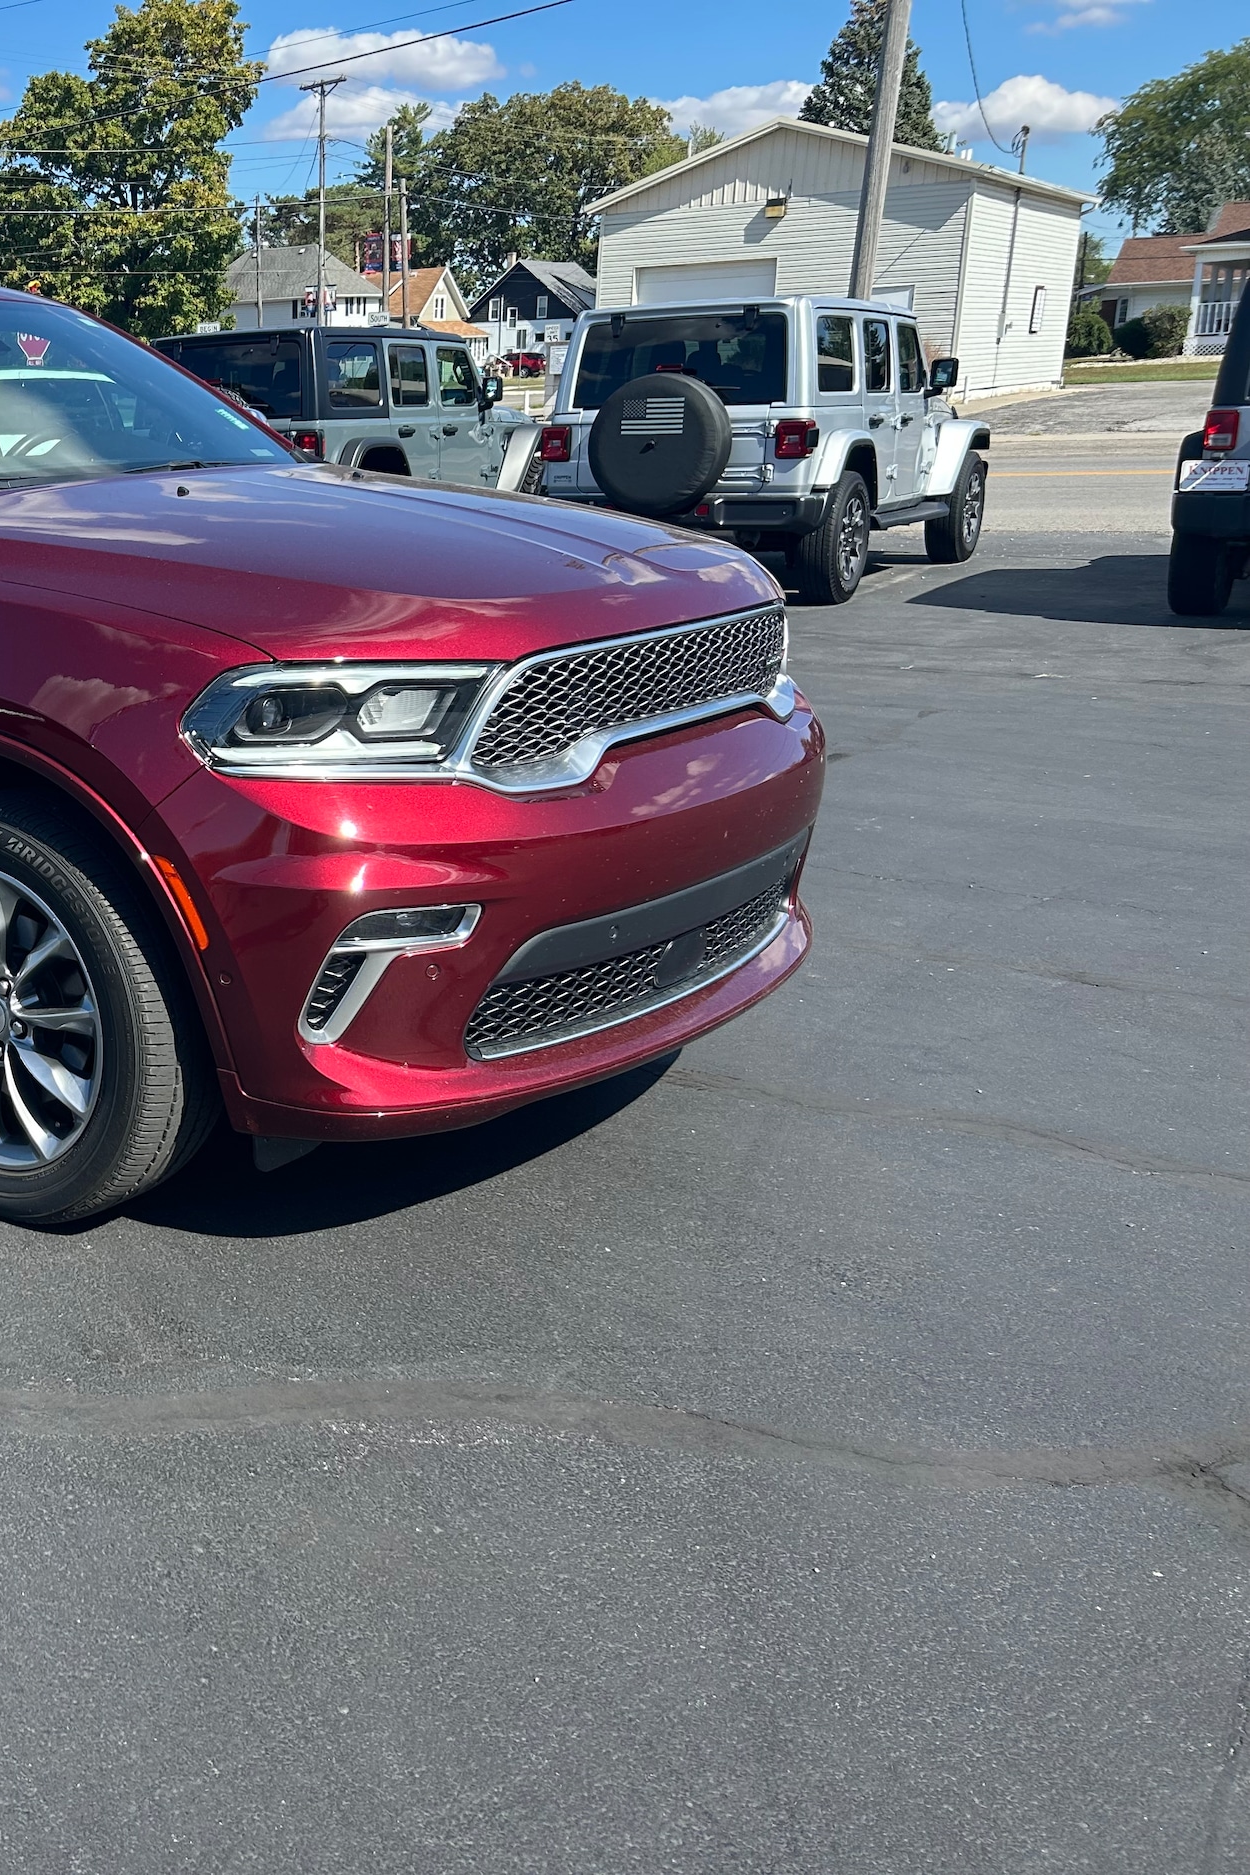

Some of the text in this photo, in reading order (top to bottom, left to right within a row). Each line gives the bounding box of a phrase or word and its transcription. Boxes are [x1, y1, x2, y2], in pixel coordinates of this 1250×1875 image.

[370, 315, 388, 323] SOUTH
[200, 325, 218, 333] BEGIN
[4, 837, 117, 975] BRIDGESTONE
